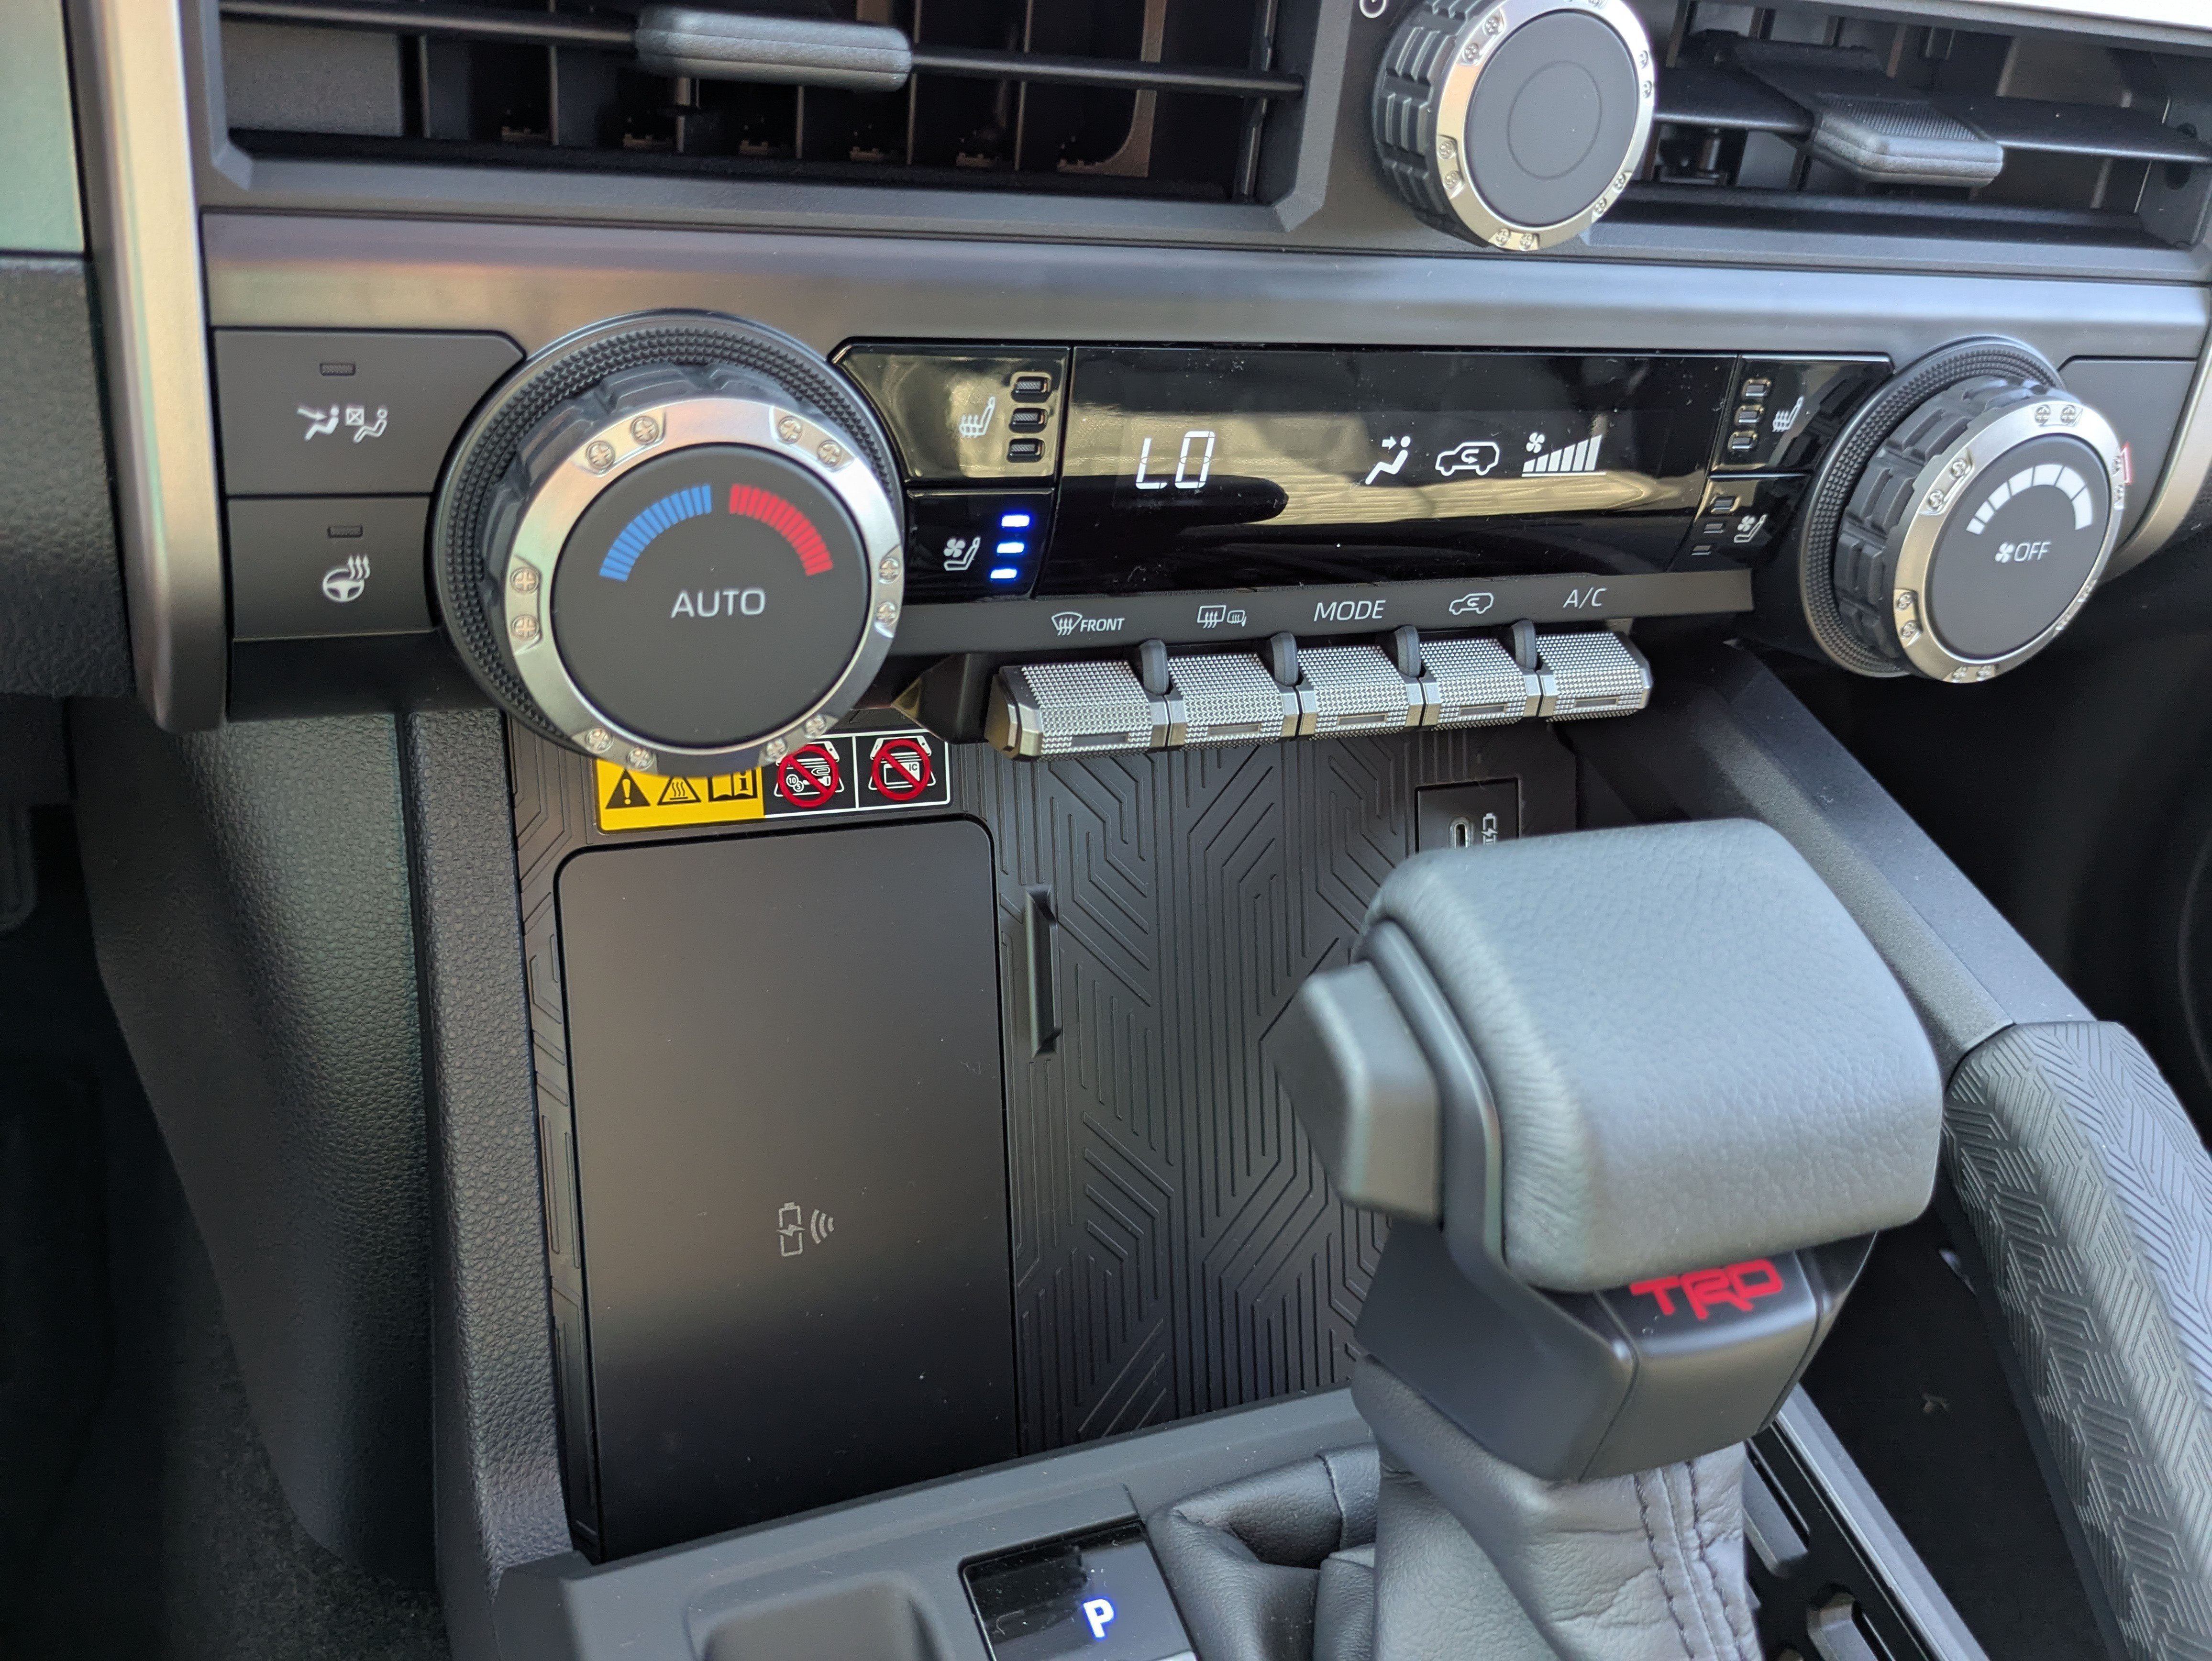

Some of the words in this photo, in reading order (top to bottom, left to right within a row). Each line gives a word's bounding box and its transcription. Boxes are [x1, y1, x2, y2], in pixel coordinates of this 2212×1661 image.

[2013, 541, 2051, 562] OFF
[671, 589, 765, 618] AUTO
[1562, 587, 1606, 609] A/C
[1314, 599, 1386, 621] MODE
[1080, 618, 1125, 632] FRONT
[1630, 1259, 1783, 1320] TRD
[1083, 1598, 1115, 1638] P
